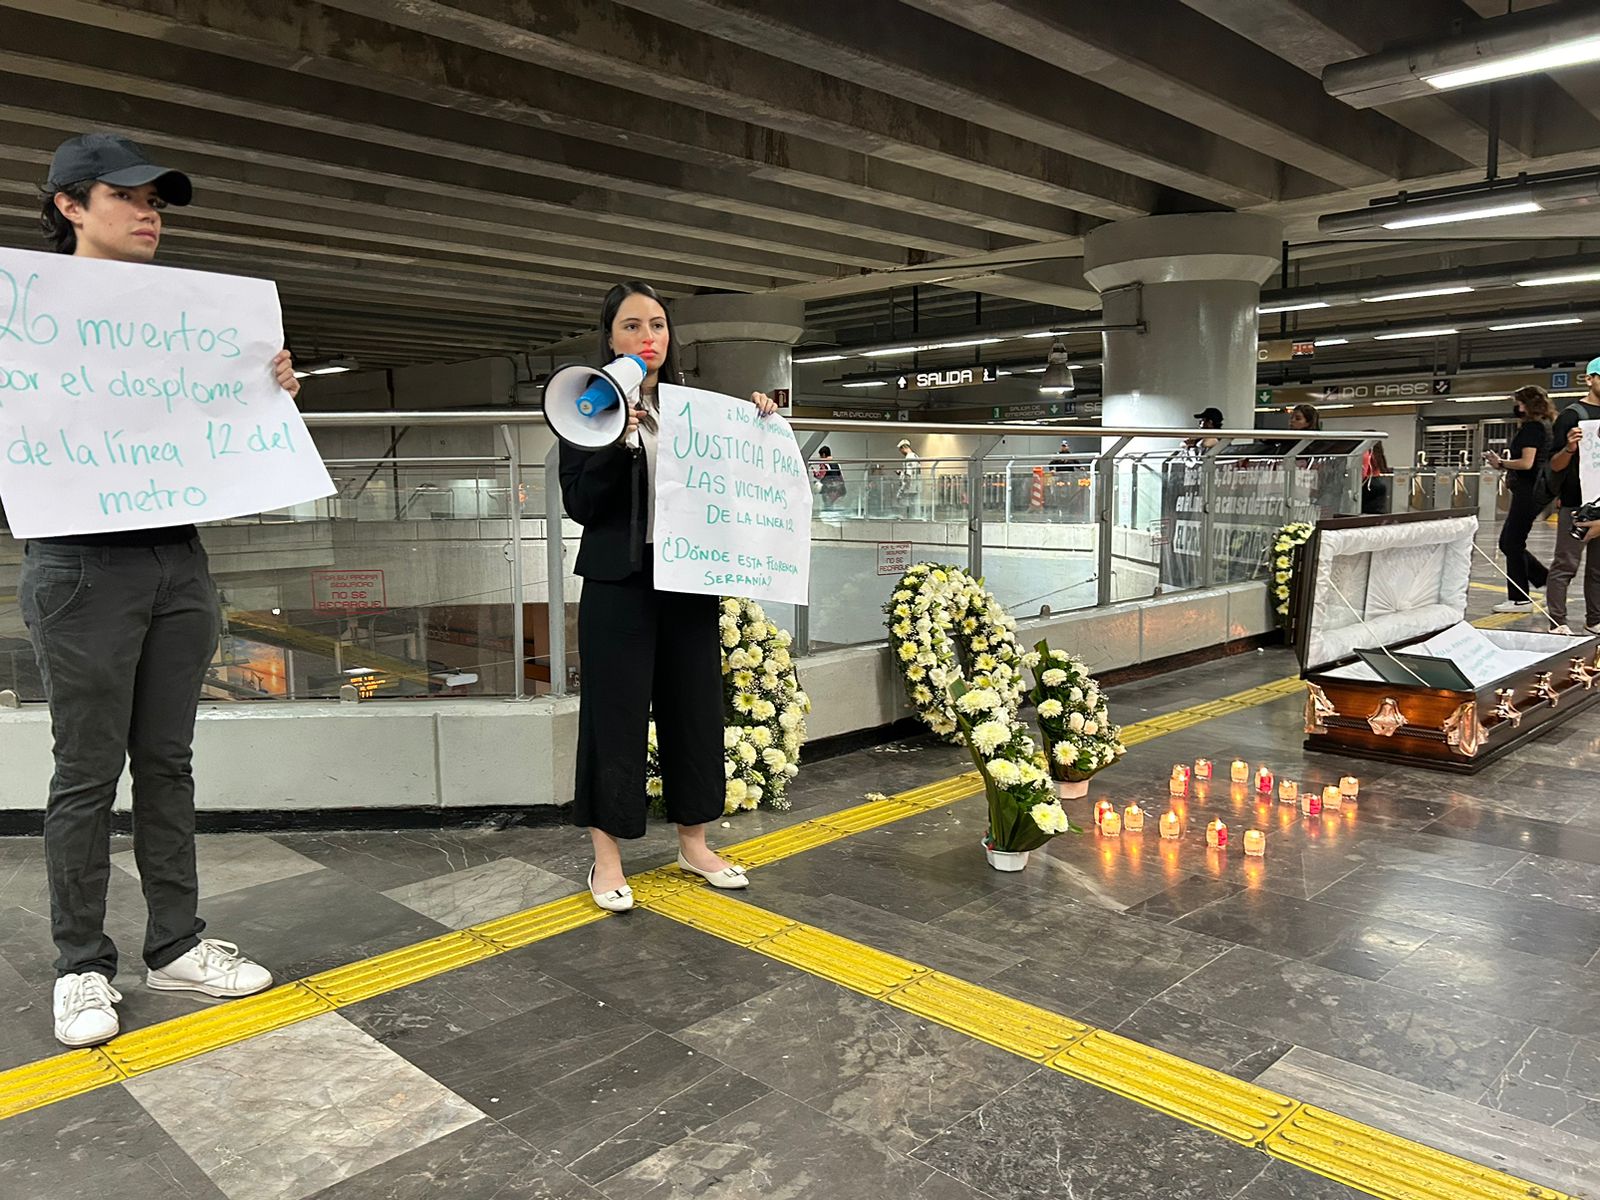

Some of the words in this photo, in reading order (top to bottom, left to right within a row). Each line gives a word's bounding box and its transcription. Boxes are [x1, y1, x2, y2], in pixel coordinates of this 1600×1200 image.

[78, 311, 241, 358] muertos
[61, 366, 92, 395] el
[108, 366, 248, 413] desplome
[916, 369, 973, 387] SALIDA
[1342, 386, 1369, 398] NO
[1374, 382, 1429, 397] PASE
[7, 425, 52, 465] de
[60, 429, 98, 467] la
[104, 429, 183, 467] línea
[206, 421, 240, 459] 12
[247, 422, 296, 453] del
[673, 401, 764, 470] JUSTICIA
[773, 447, 800, 477] PARA
[99, 479, 207, 515] metro
[685, 465, 726, 495] LAS
[735, 479, 788, 510] VICTIMAS
[706, 504, 731, 524] DE
[737, 511, 752, 525] LA
[756, 513, 784, 529] LINEA
[785, 518, 795, 533] 12
[737, 554, 763, 570] ESTA
[332, 591, 348, 599] NO
[351, 591, 367, 599] SE
